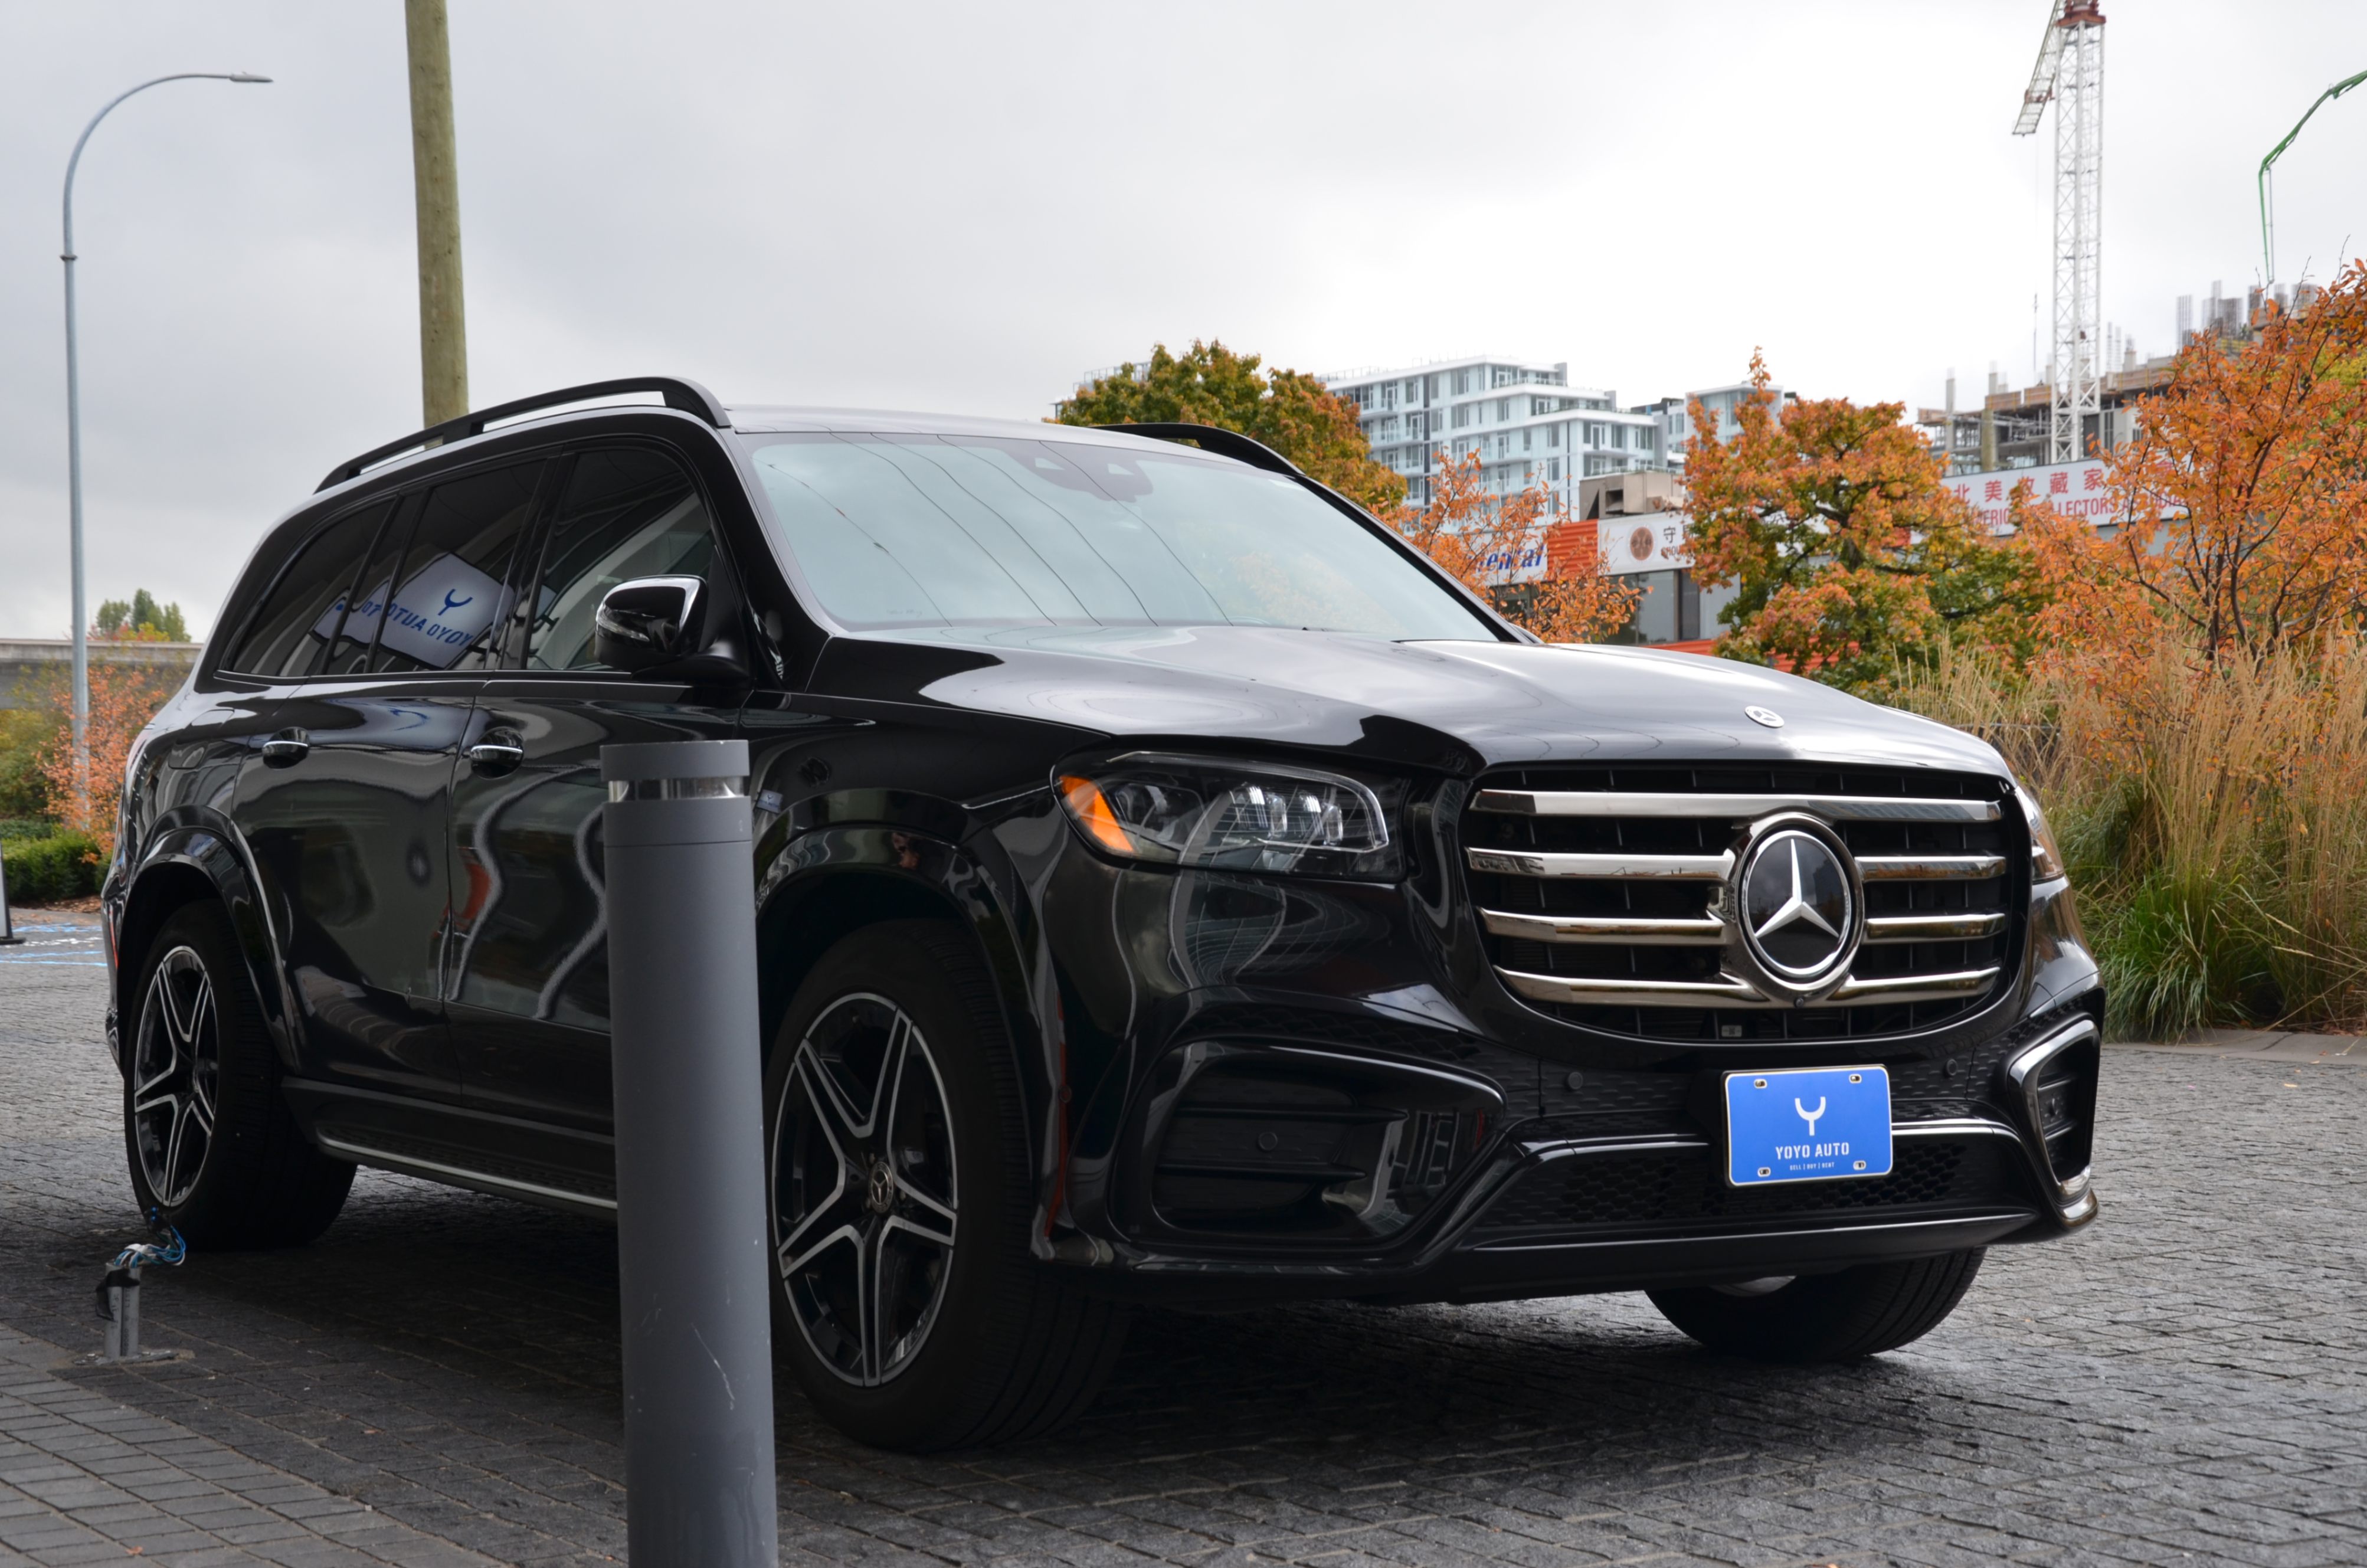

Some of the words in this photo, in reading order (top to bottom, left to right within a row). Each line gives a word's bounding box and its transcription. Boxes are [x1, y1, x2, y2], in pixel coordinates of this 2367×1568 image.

[2052, 497, 2117, 518] LECTORS
[1775, 1145, 1811, 1160] YOYO
[1815, 1142, 1849, 1157] AUTO
